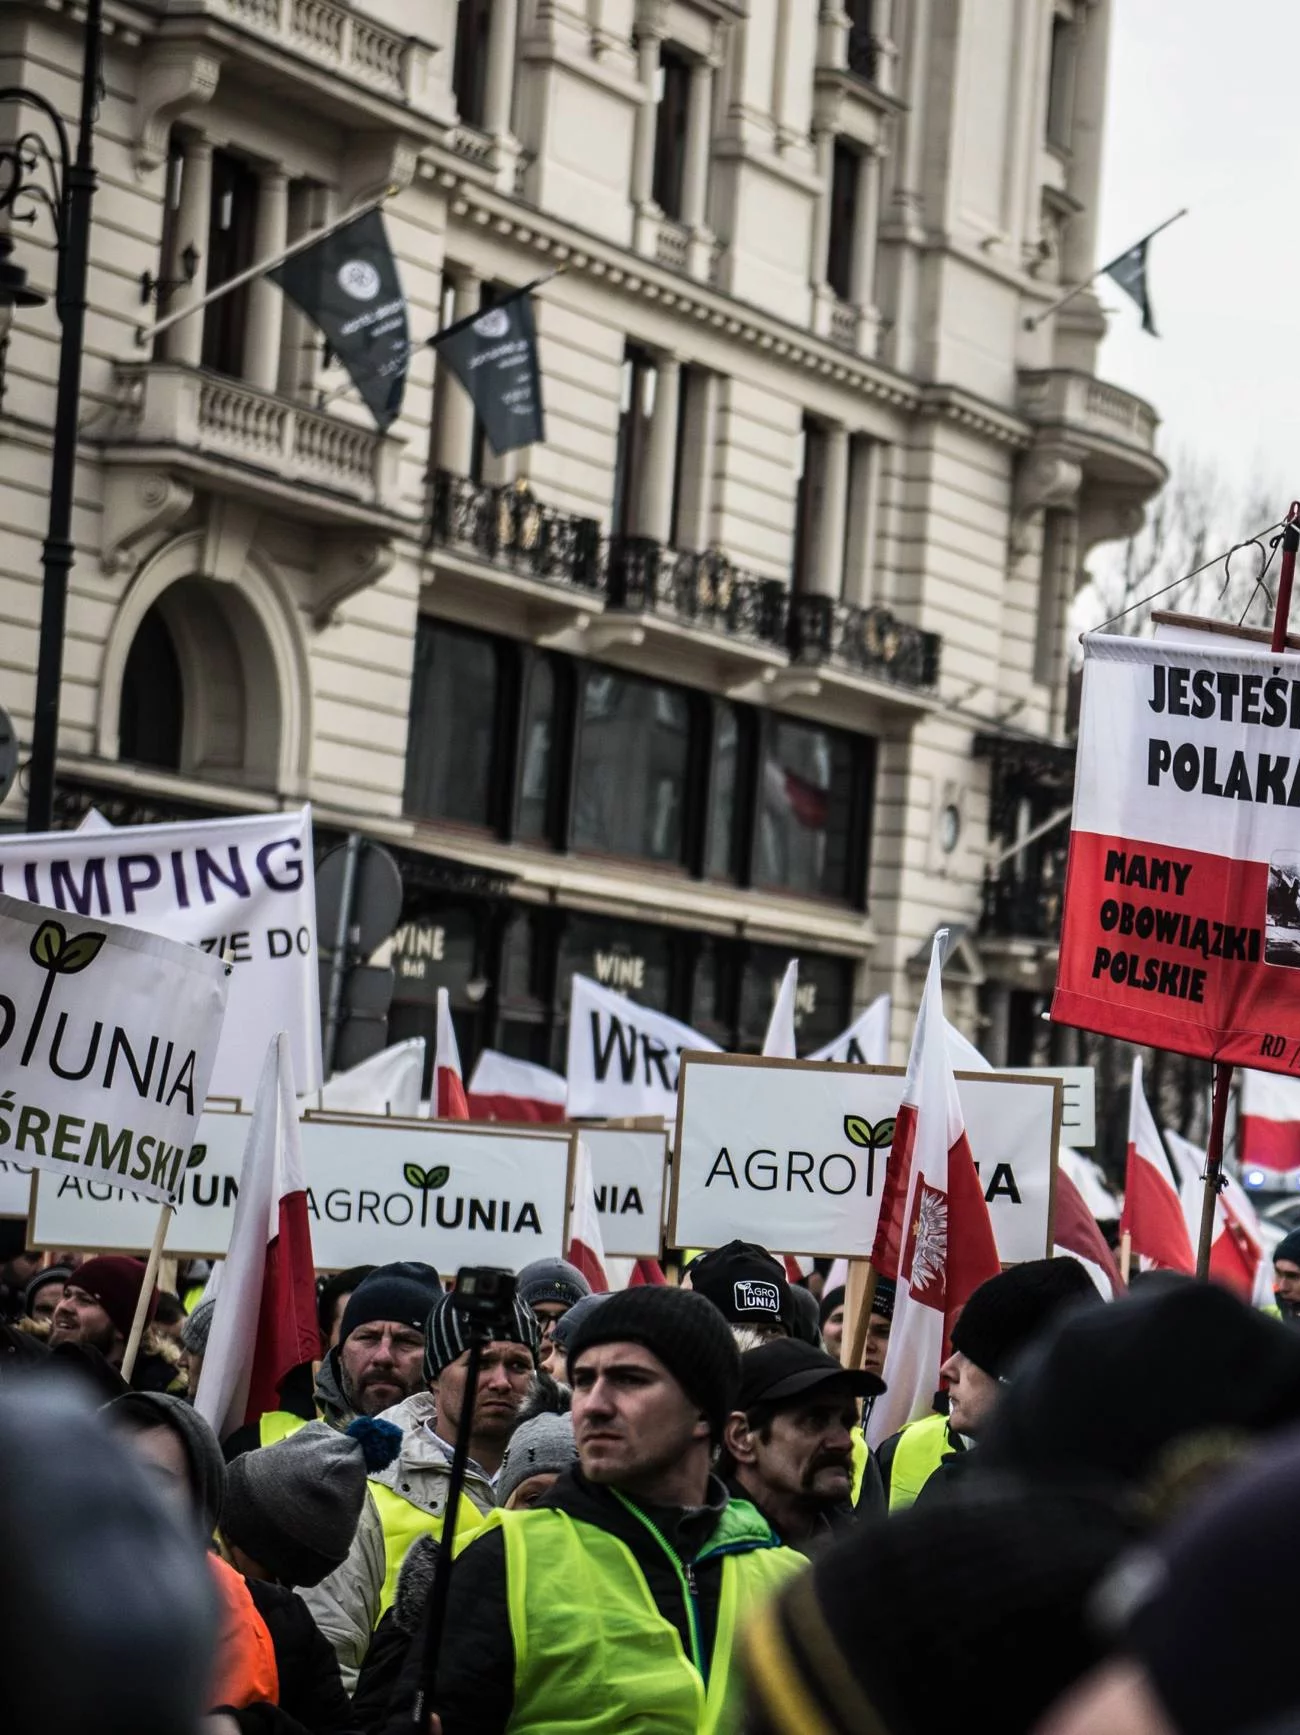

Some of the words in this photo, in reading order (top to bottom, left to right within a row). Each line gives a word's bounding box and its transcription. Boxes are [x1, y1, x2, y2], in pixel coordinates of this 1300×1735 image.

[1103, 850, 1193, 896] MAMY
[266, 926, 310, 959] DO
[1100, 899, 1261, 963] OBOWIĄZKI
[595, 951, 646, 990] WINE
[1092, 946, 1208, 1004] POLSKIE
[1259, 1033, 1287, 1059] RD
[746, 1296, 777, 1310] UNIA
[747, 1286, 775, 1299] AGRO
